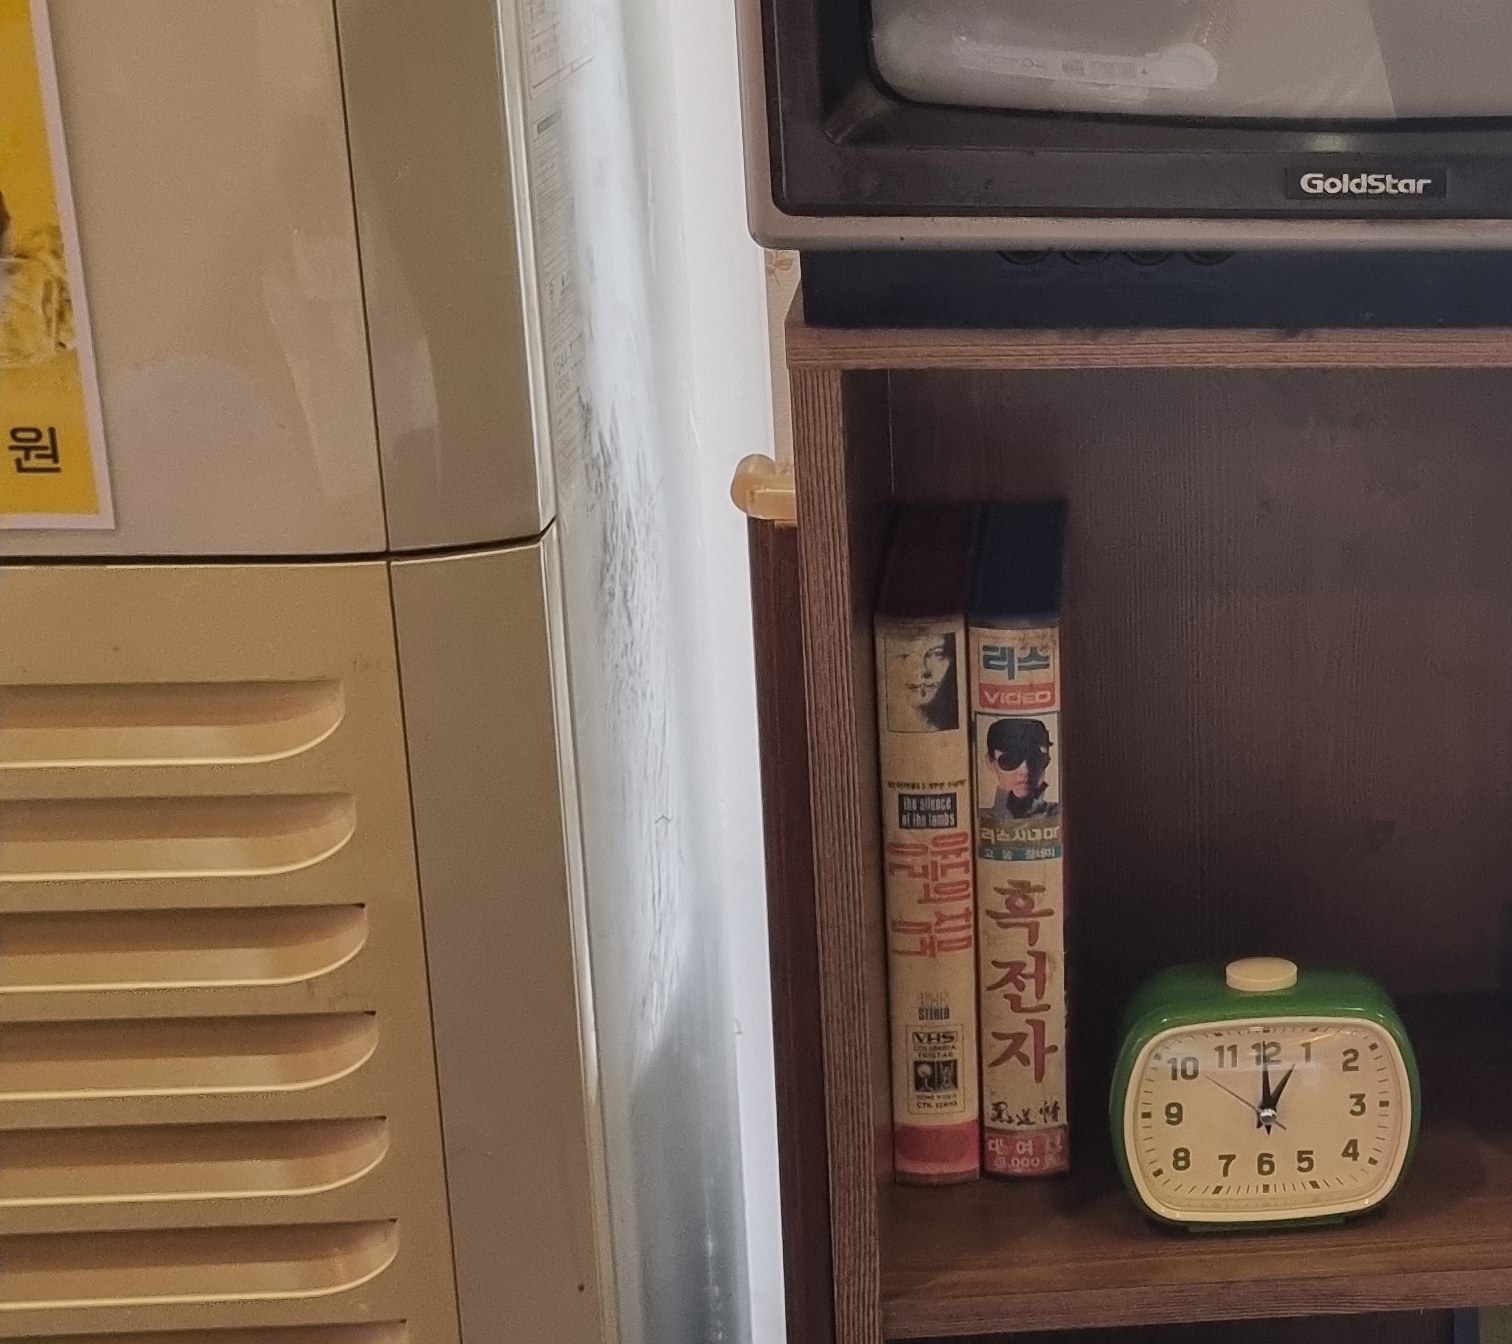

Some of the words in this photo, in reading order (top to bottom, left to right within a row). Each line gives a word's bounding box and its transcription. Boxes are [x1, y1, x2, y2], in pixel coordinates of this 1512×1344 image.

[1300, 173, 1432, 194] GoldStar
[8, 426, 61, 475] 원
[982, 645, 1050, 680] 리스
[984, 690, 1051, 705] VIDEO
[985, 878, 1058, 1084] 흑전자
[918, 1007, 950, 1021] STEREO
[913, 1031, 957, 1044] VHS
[1213, 1044, 1238, 1068] 11
[1251, 1042, 1282, 1066] 12
[1300, 1041, 1313, 1063] 1
[1342, 1048, 1360, 1072] 2
[1167, 1056, 1200, 1081] 10
[1164, 1101, 1183, 1126] 9
[1348, 1093, 1367, 1117] 3
[1172, 1147, 1191, 1172] 8
[1296, 1149, 1315, 1172] 5
[1340, 1138, 1360, 1162] 4
[1218, 1154, 1236, 1177] 7
[1256, 1152, 1276, 1176] 6
